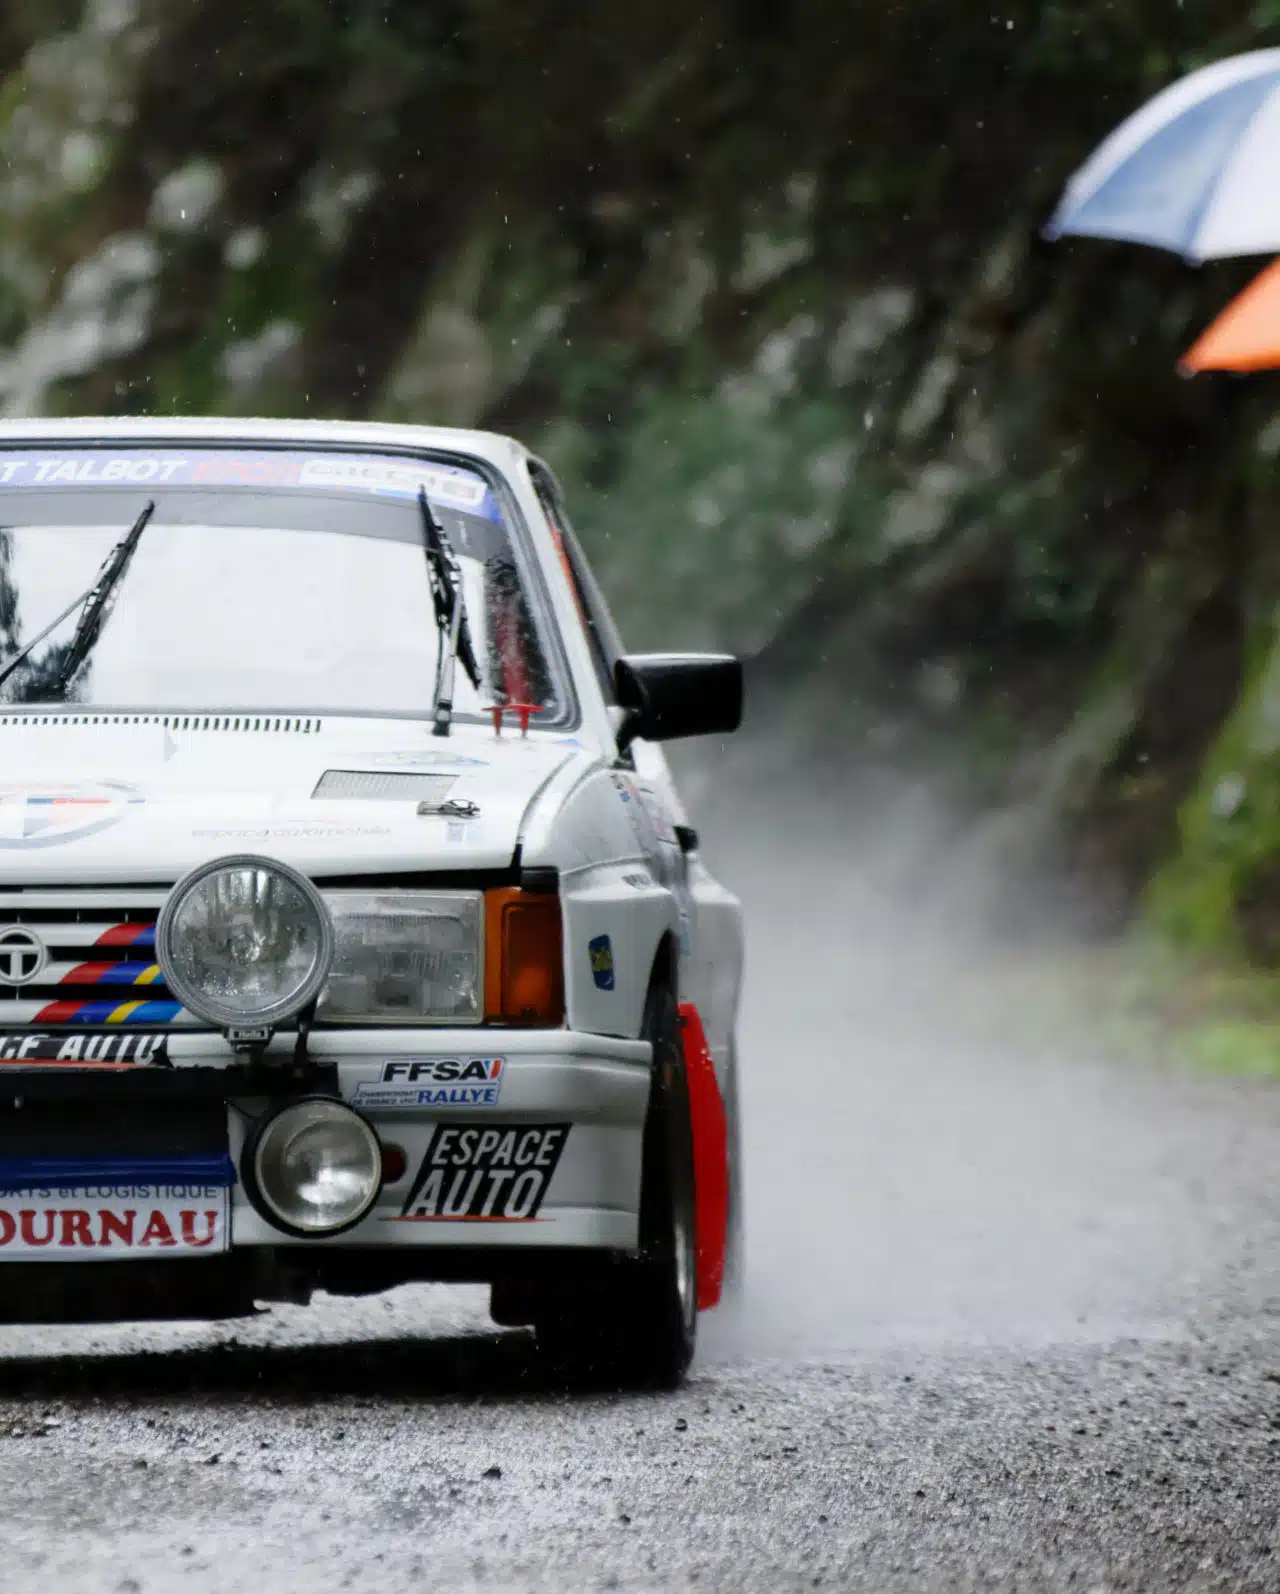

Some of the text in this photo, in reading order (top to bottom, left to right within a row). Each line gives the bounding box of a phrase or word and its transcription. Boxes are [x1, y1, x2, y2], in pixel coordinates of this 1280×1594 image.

[33, 459, 187, 482] TALBOT
[382, 1060, 488, 1082] FFSA
[417, 1088, 496, 1105] RALLYE
[431, 1129, 563, 1167] ESPACE
[406, 1169, 544, 1219] AUTO
